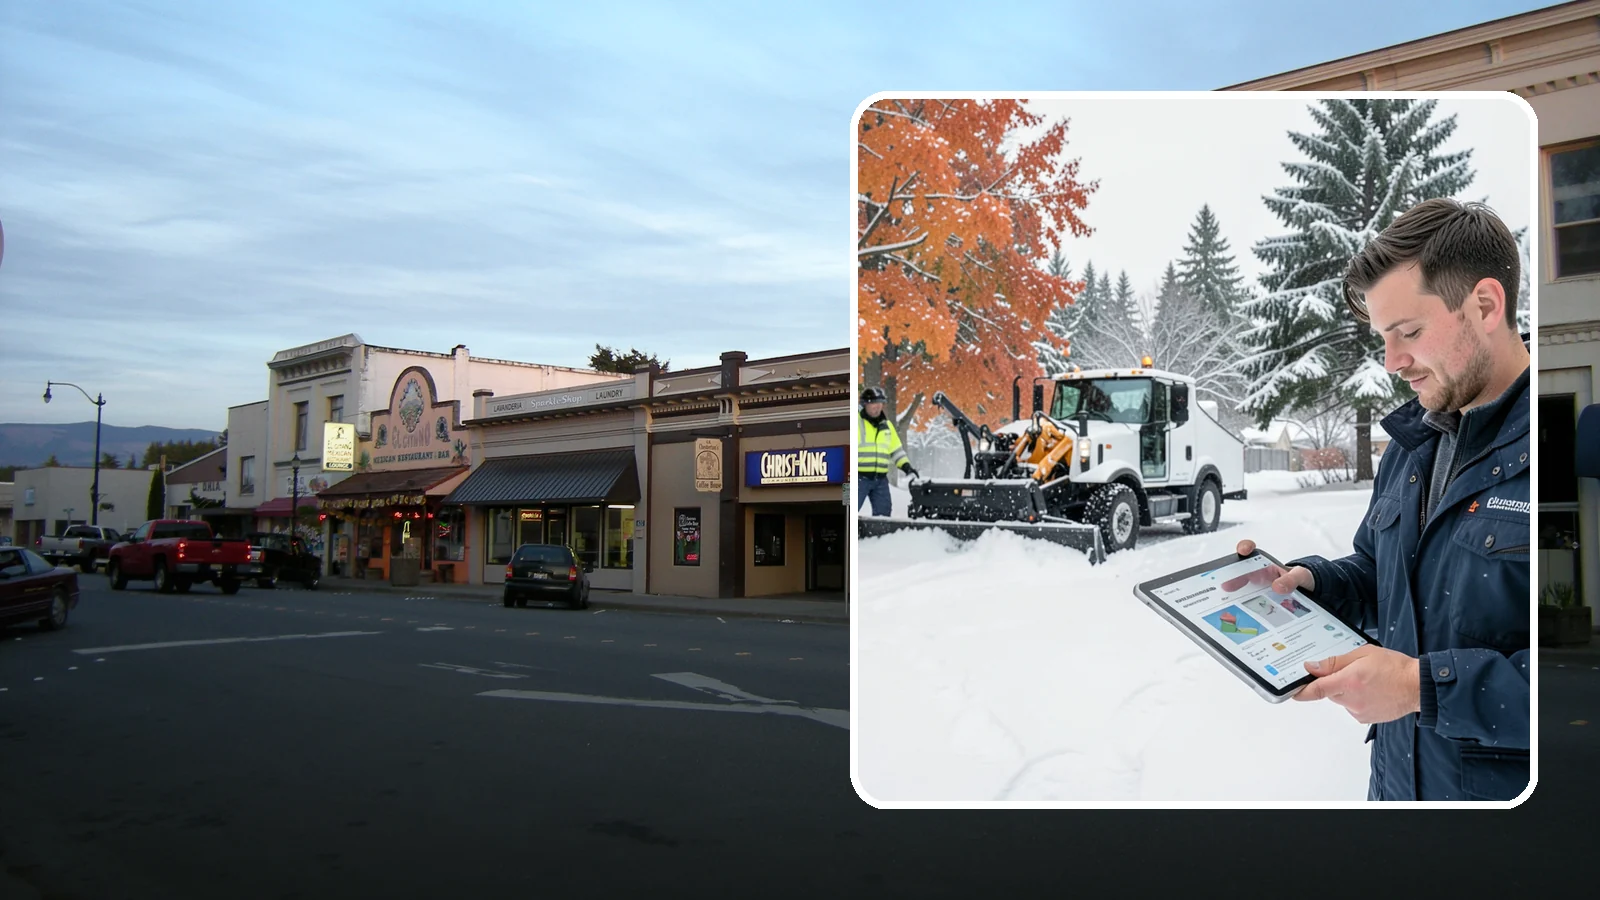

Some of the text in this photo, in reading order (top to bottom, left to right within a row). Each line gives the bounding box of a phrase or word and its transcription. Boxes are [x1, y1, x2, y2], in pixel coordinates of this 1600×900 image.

[595, 388, 624, 400] LAUNDRY
[493, 402, 523, 413] LAVANDERIA
[397, 452, 434, 463] RESTAURANT
[438, 450, 450, 459] BAR
[760, 449, 828, 478] CHRIST KING
